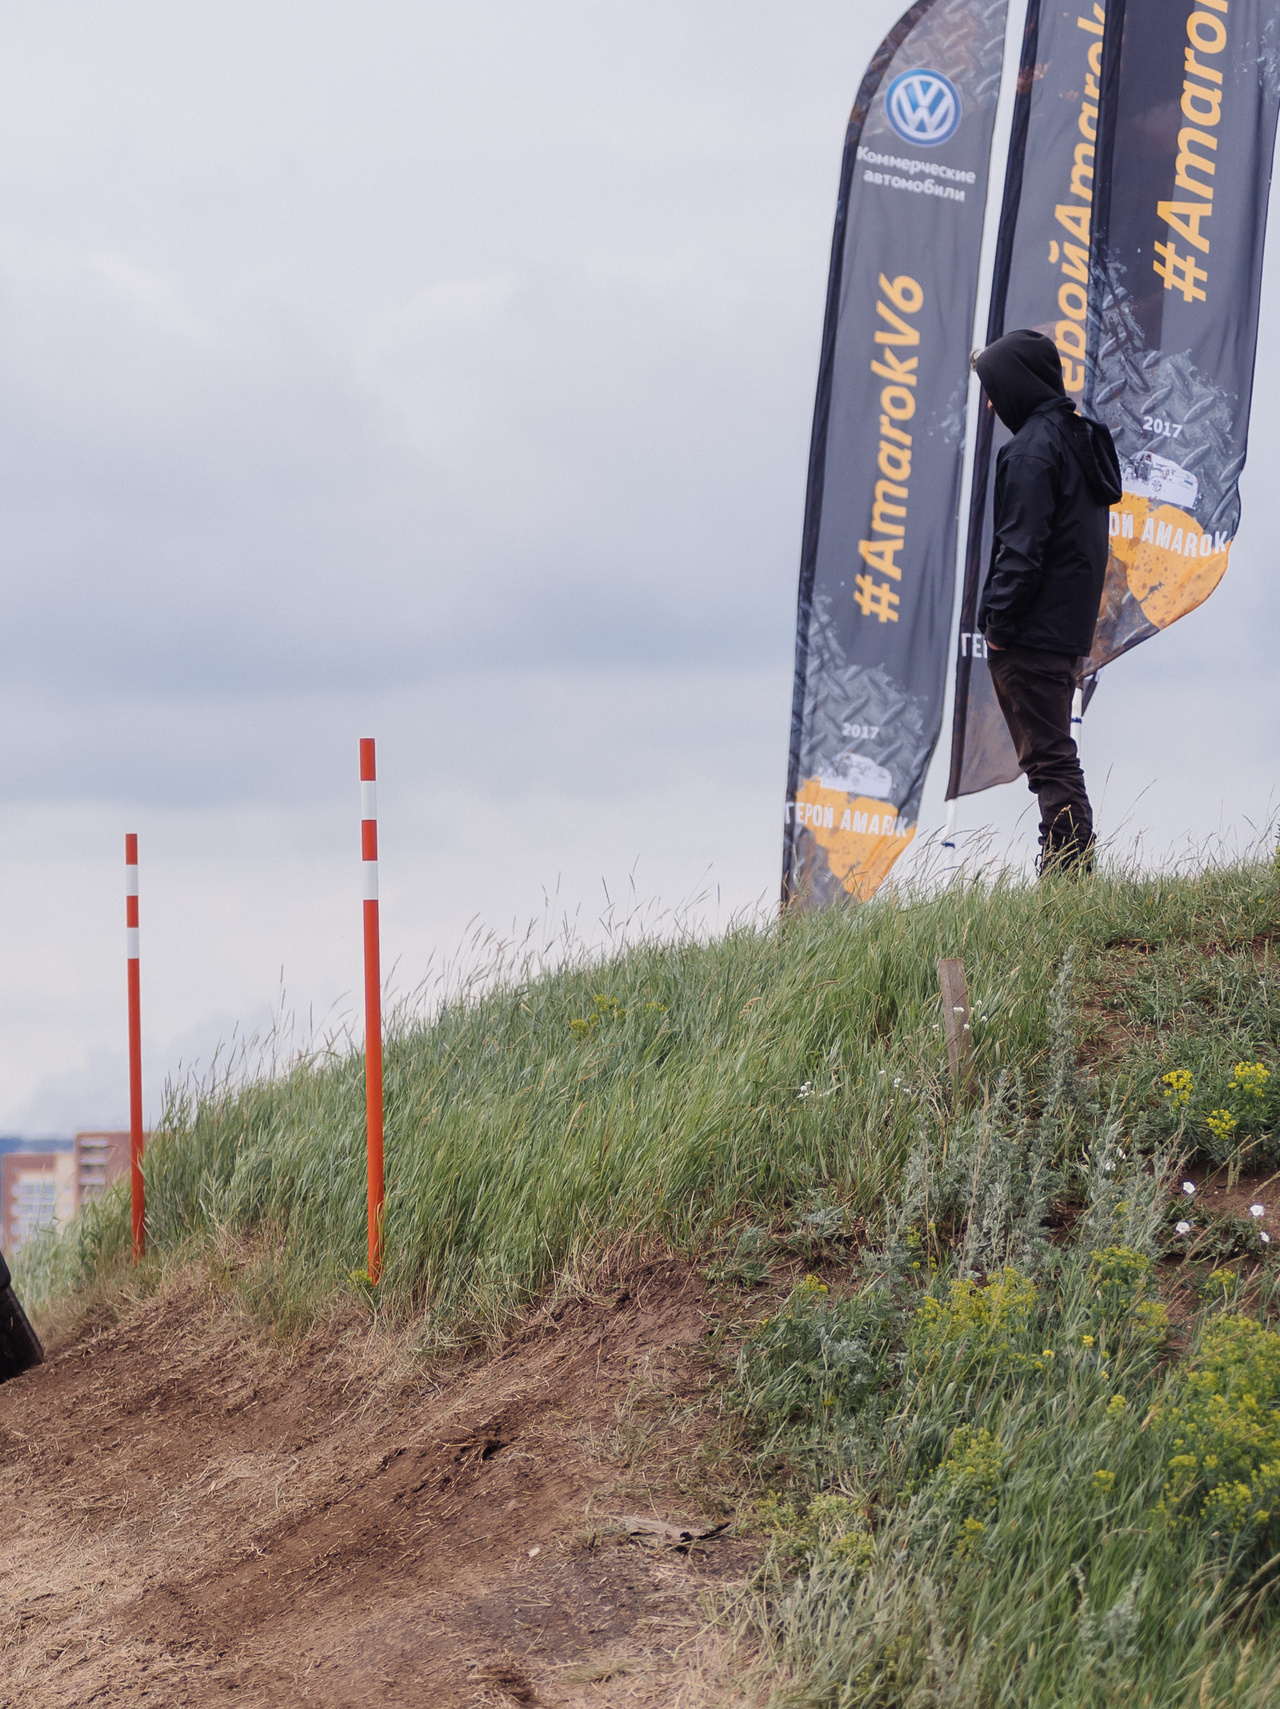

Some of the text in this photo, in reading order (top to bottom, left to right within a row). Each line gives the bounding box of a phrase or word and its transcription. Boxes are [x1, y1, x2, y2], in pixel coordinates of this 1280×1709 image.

[857, 145, 977, 185] Коммерческие
[863, 169, 966, 202] автомобили
[1142, 416, 1183, 438] 2017
[853, 272, 924, 623] #AmarokV6
[1141, 517, 1228, 558] AMAROK
[842, 722, 880, 739] 2017
[785, 801, 834, 829] ГЕРОЙ
